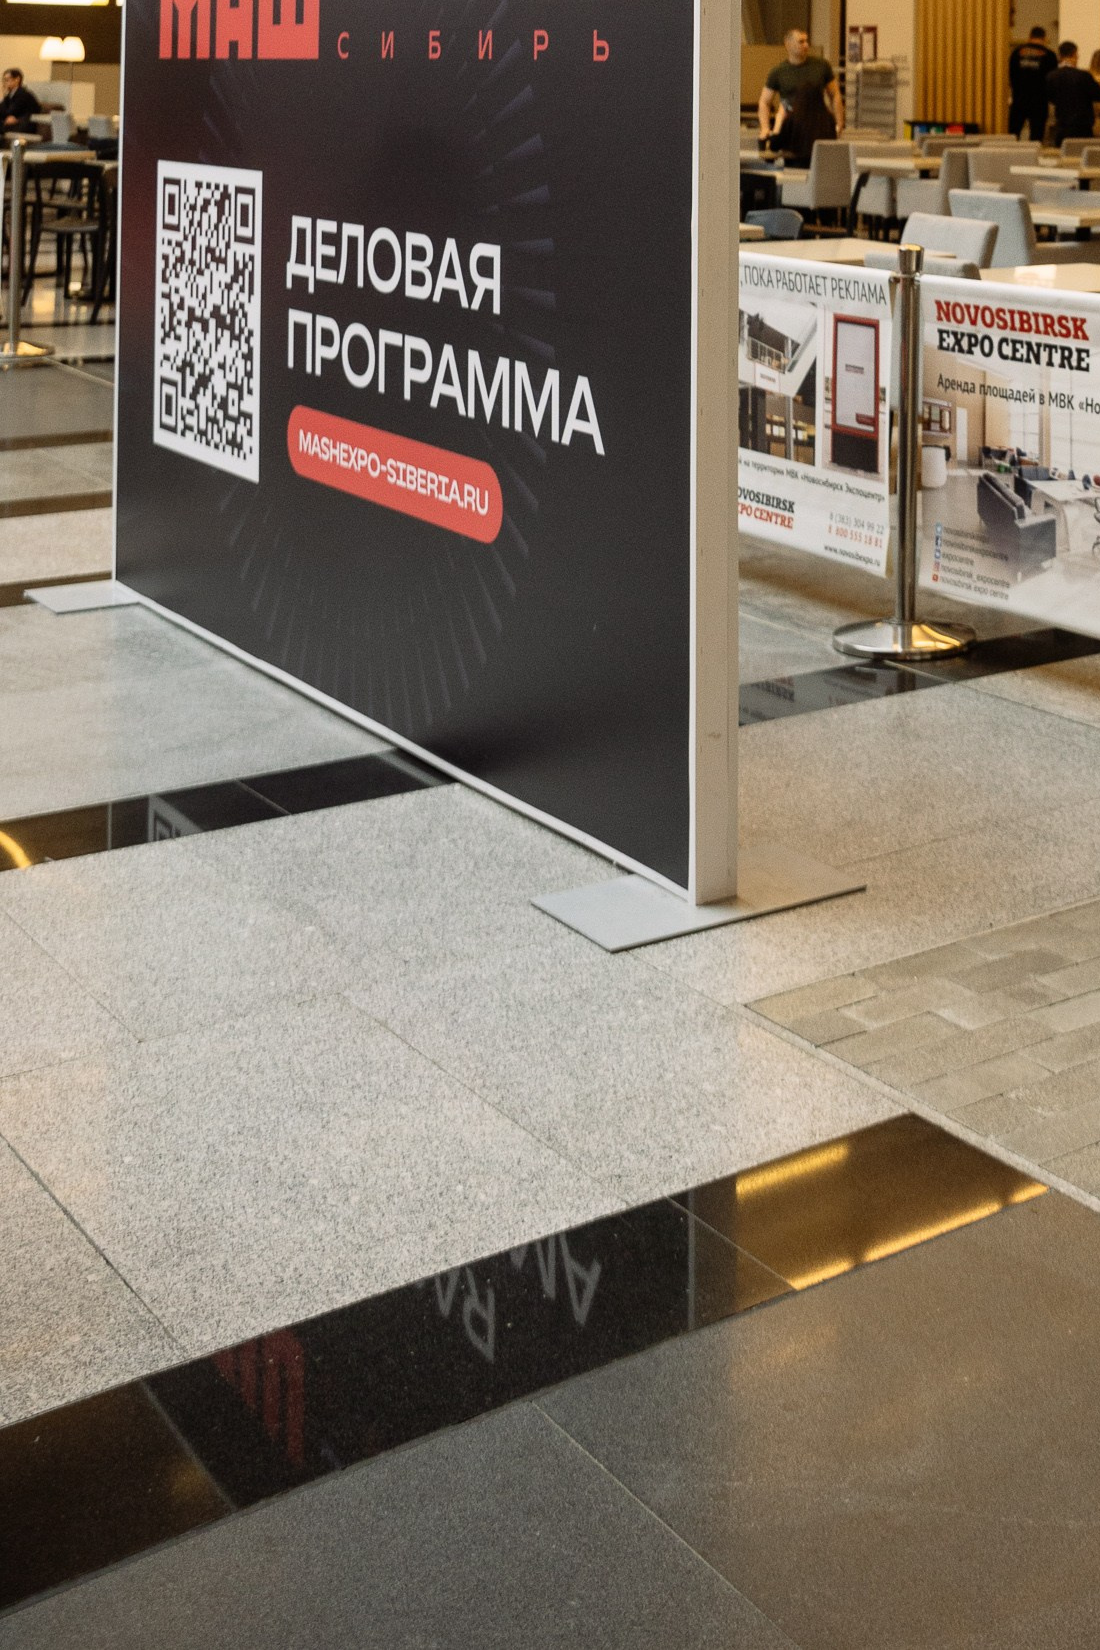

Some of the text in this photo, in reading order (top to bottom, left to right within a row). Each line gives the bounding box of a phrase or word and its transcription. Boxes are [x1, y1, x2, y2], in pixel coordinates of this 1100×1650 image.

[337, 29, 610, 62] СИБИРЬ
[286, 215, 501, 315] ДЕЛОВАЯ
[744, 265, 887, 306] ПОКА РАБОТАЕТ РЕКЛАМА
[935, 299, 1090, 341] NOVOSIBIRSK
[937, 328, 1090, 372] EXPO CENTRE
[287, 308, 605, 456] ПРОГРАММА
[937, 373, 976, 395] Аренда
[979, 383, 1036, 405] площадей
[1038, 394, 1046, 406] в
[1048, 391, 1075, 411] МВК
[299, 428, 488, 516] MASHEXPO-SIBERIA.RU
[753, 507, 794, 530] CENTRE
